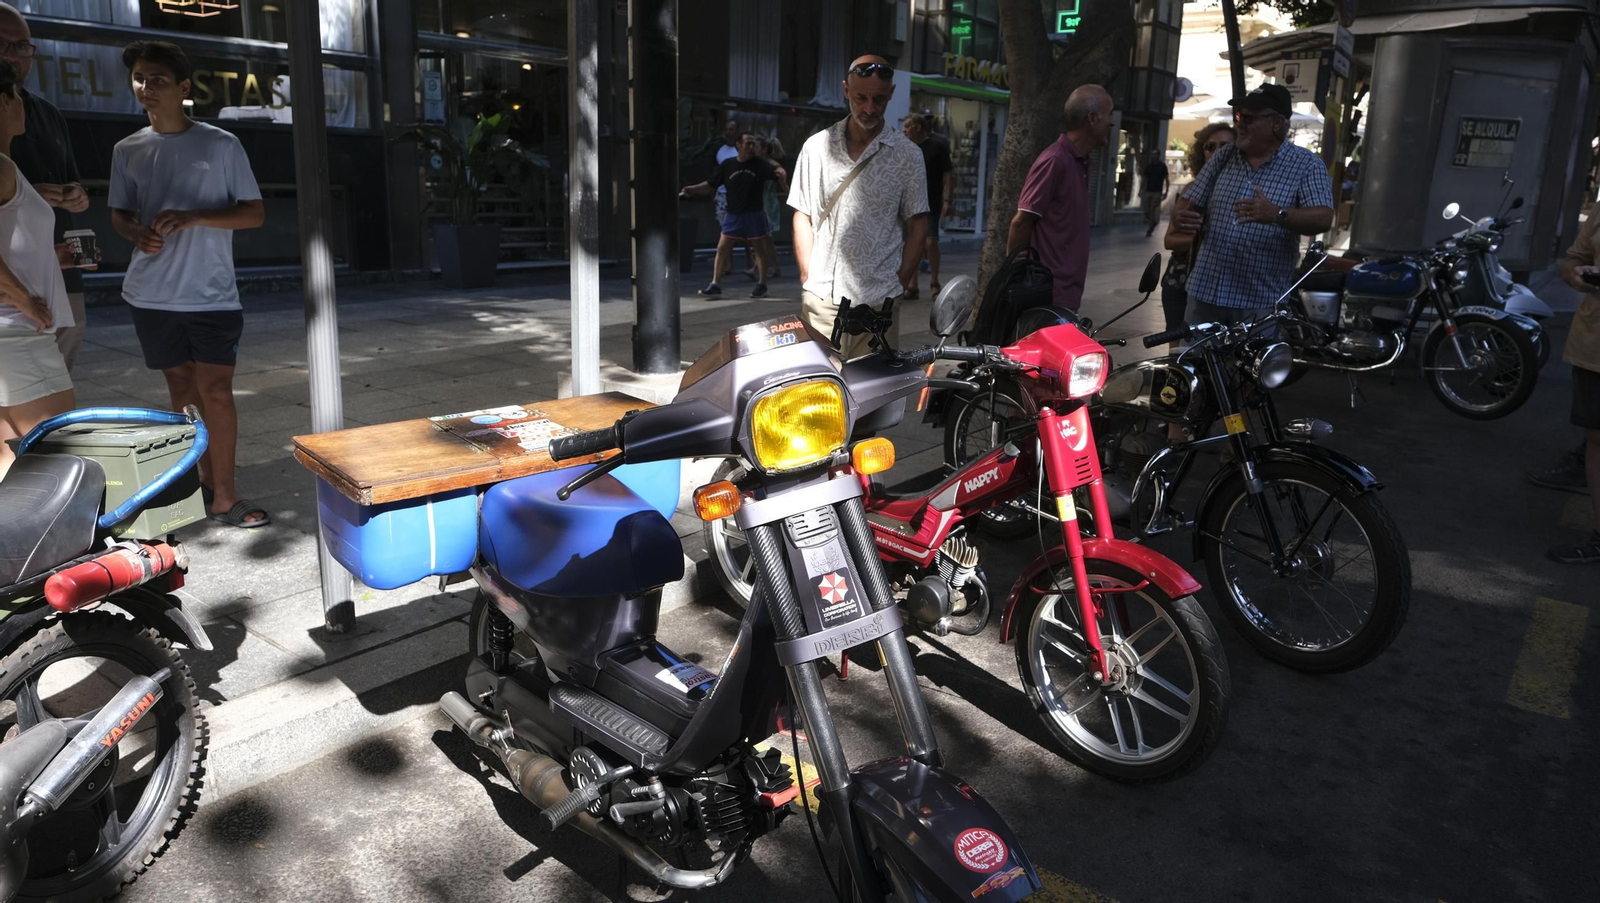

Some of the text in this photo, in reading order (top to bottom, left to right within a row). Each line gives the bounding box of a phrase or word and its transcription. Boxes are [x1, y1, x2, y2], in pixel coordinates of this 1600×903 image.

[33, 55, 113, 97] TEL
[1461, 120, 1517, 139] SE ALQUILA
[770, 320, 804, 334] RACING
[964, 466, 999, 493] HAPPY
[822, 599, 855, 612] UMBRELLA
[823, 603, 858, 618] CORPORATION
[100, 691, 155, 748] YASUNI
[958, 830, 989, 850] MITICA
